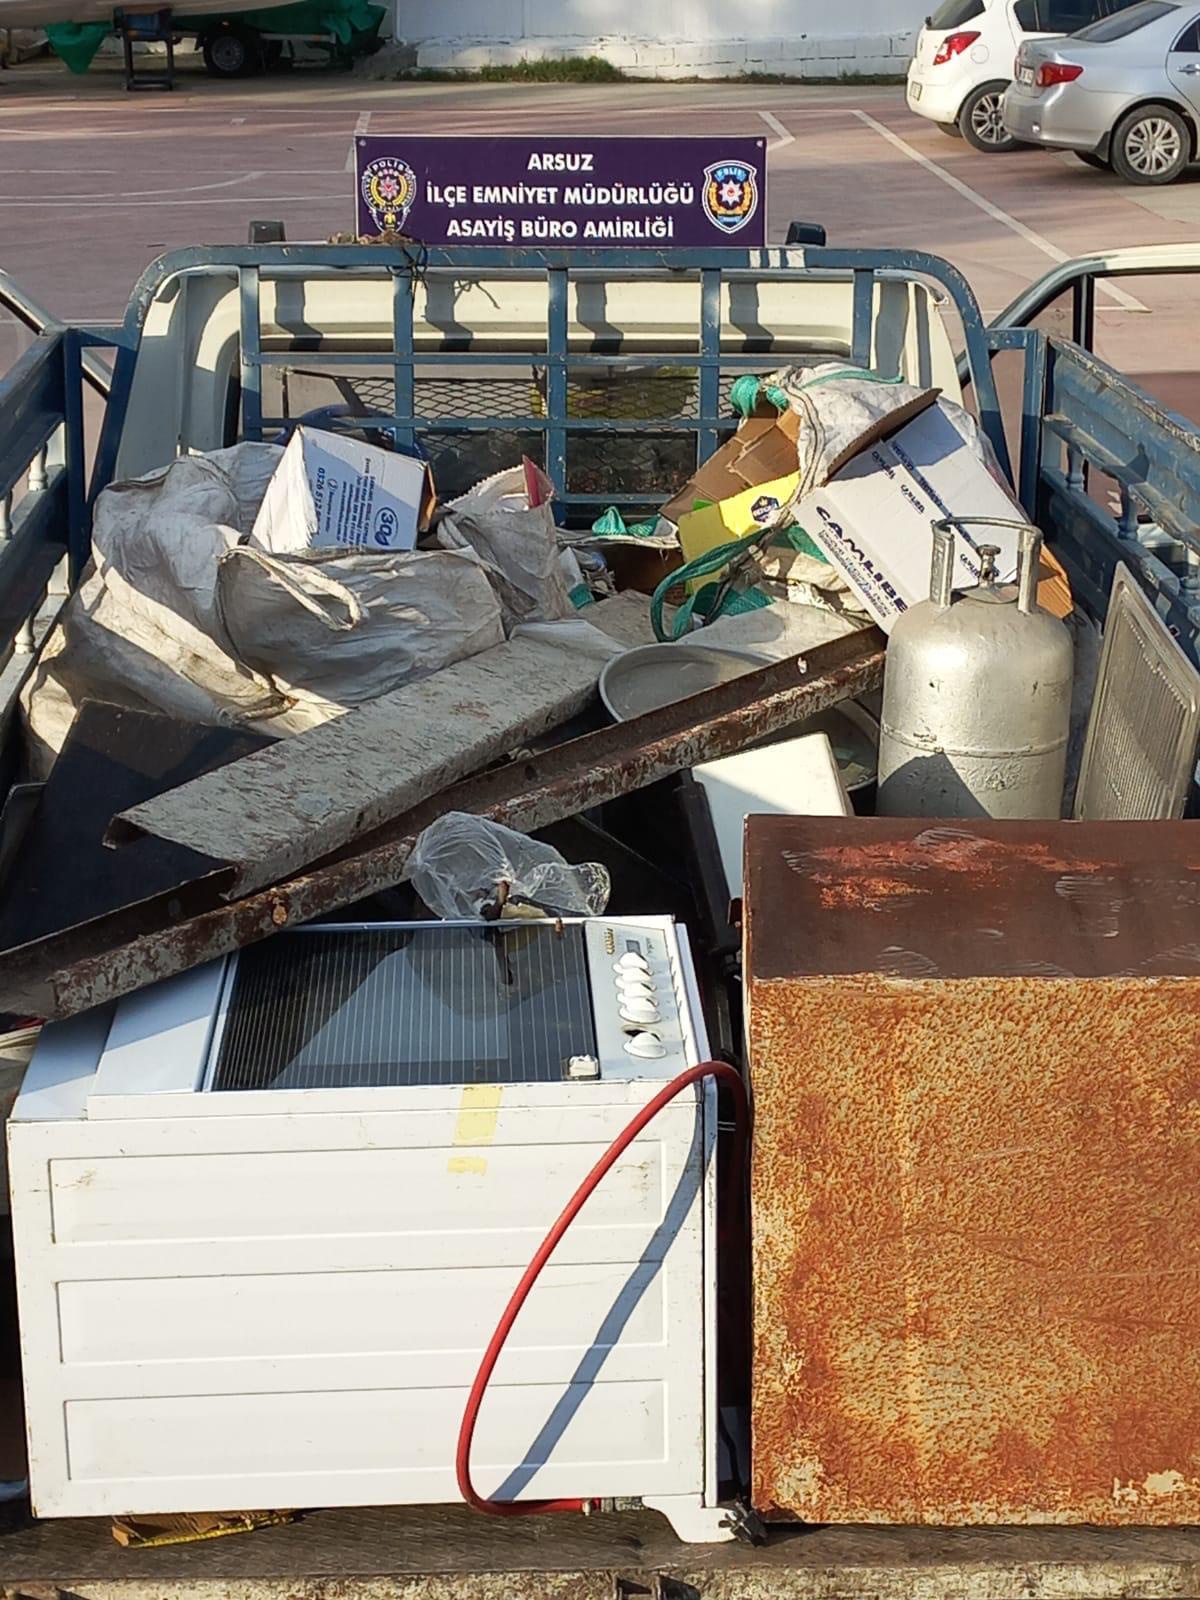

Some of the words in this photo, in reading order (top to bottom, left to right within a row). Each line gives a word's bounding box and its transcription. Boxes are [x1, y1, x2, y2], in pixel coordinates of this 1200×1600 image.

[528, 153, 593, 171] ARSUZ
[426, 181, 466, 208] İLÇE
[473, 182, 558, 204] EMNİYET
[564, 182, 694, 204] MÜDÜRLÜĞÜ
[447, 216, 515, 241] ASAYİŞ
[521, 216, 578, 237] BÜRO
[583, 216, 674, 238] AMİRLİĞİ
[816, 506, 908, 613] CAMLIBE
